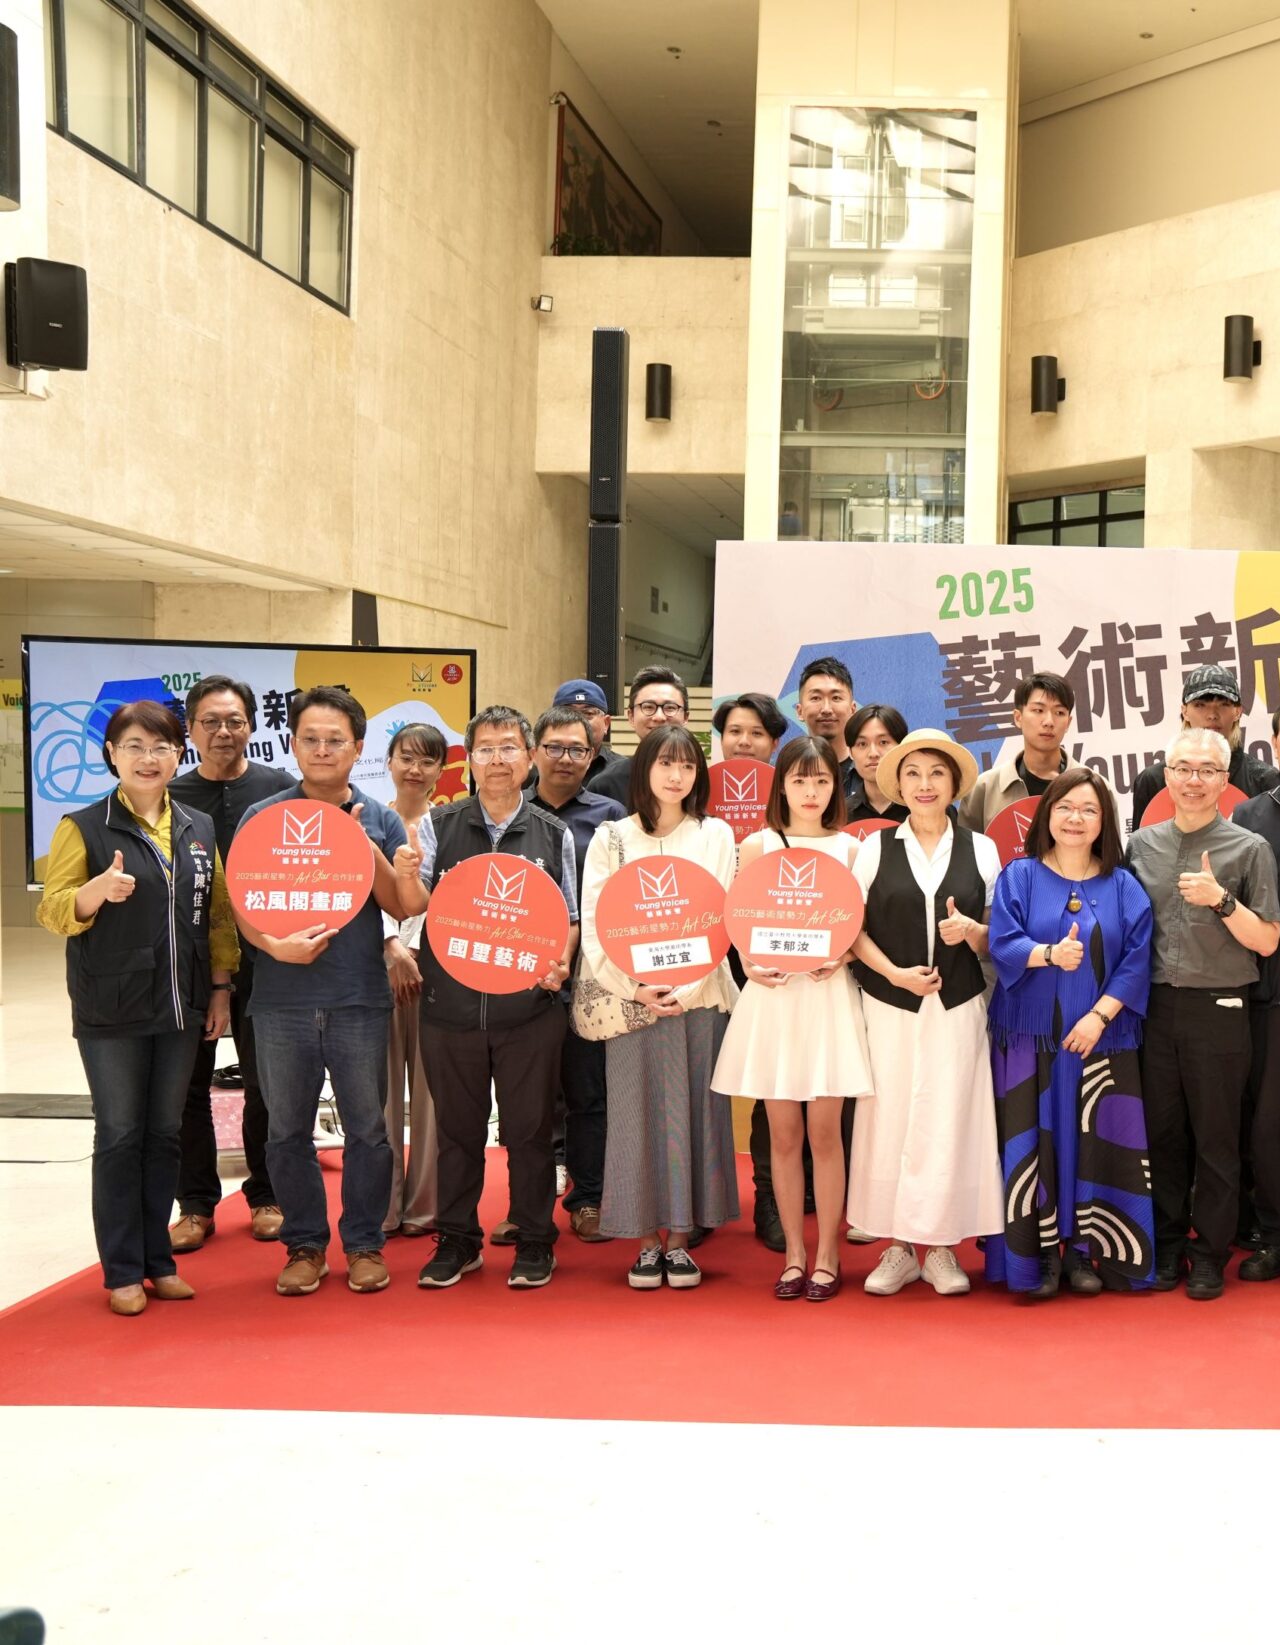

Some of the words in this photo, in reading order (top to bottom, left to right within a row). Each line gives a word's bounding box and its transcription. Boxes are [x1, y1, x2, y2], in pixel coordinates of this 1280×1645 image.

[935, 567, 1035, 620] 2025
[272, 847, 299, 857] Young
[301, 848, 331, 856] Voices
[293, 871, 310, 887] Art
[312, 869, 331, 883] Star
[245, 890, 353, 912] 松風閣畫廊
[767, 889, 794, 898] Young
[794, 890, 823, 899] Voices
[472, 897, 499, 910] Young
[500, 905, 529, 916] Voices
[634, 902, 660, 911] Young
[661, 898, 689, 908] Voices
[681, 916, 698, 936] Art
[701, 911, 723, 928] Star
[806, 911, 825, 928] Art
[829, 907, 854, 924] Star
[490, 928, 506, 940] Art
[507, 926, 526, 941] Star
[448, 937, 538, 973] 國璽藝術
[769, 939, 810, 953] 李郁汝
[652, 951, 691, 967] 謝立宜
